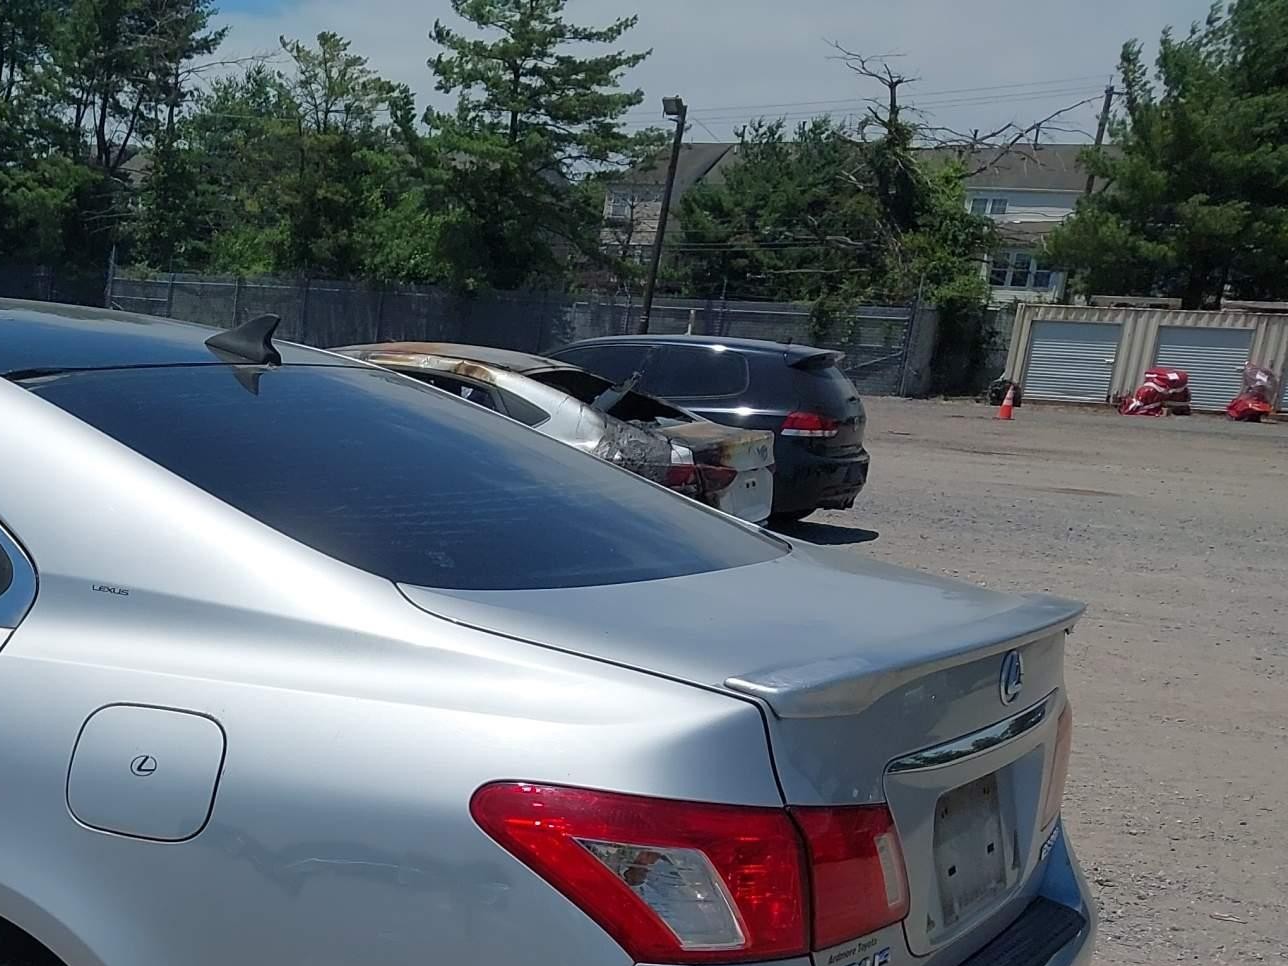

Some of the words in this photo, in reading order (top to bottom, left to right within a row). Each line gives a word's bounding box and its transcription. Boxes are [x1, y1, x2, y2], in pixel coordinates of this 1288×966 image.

[92, 584, 129, 596] LEXUS
[828, 946, 857, 965] Ardmore
[857, 938, 878, 953] Toyota
